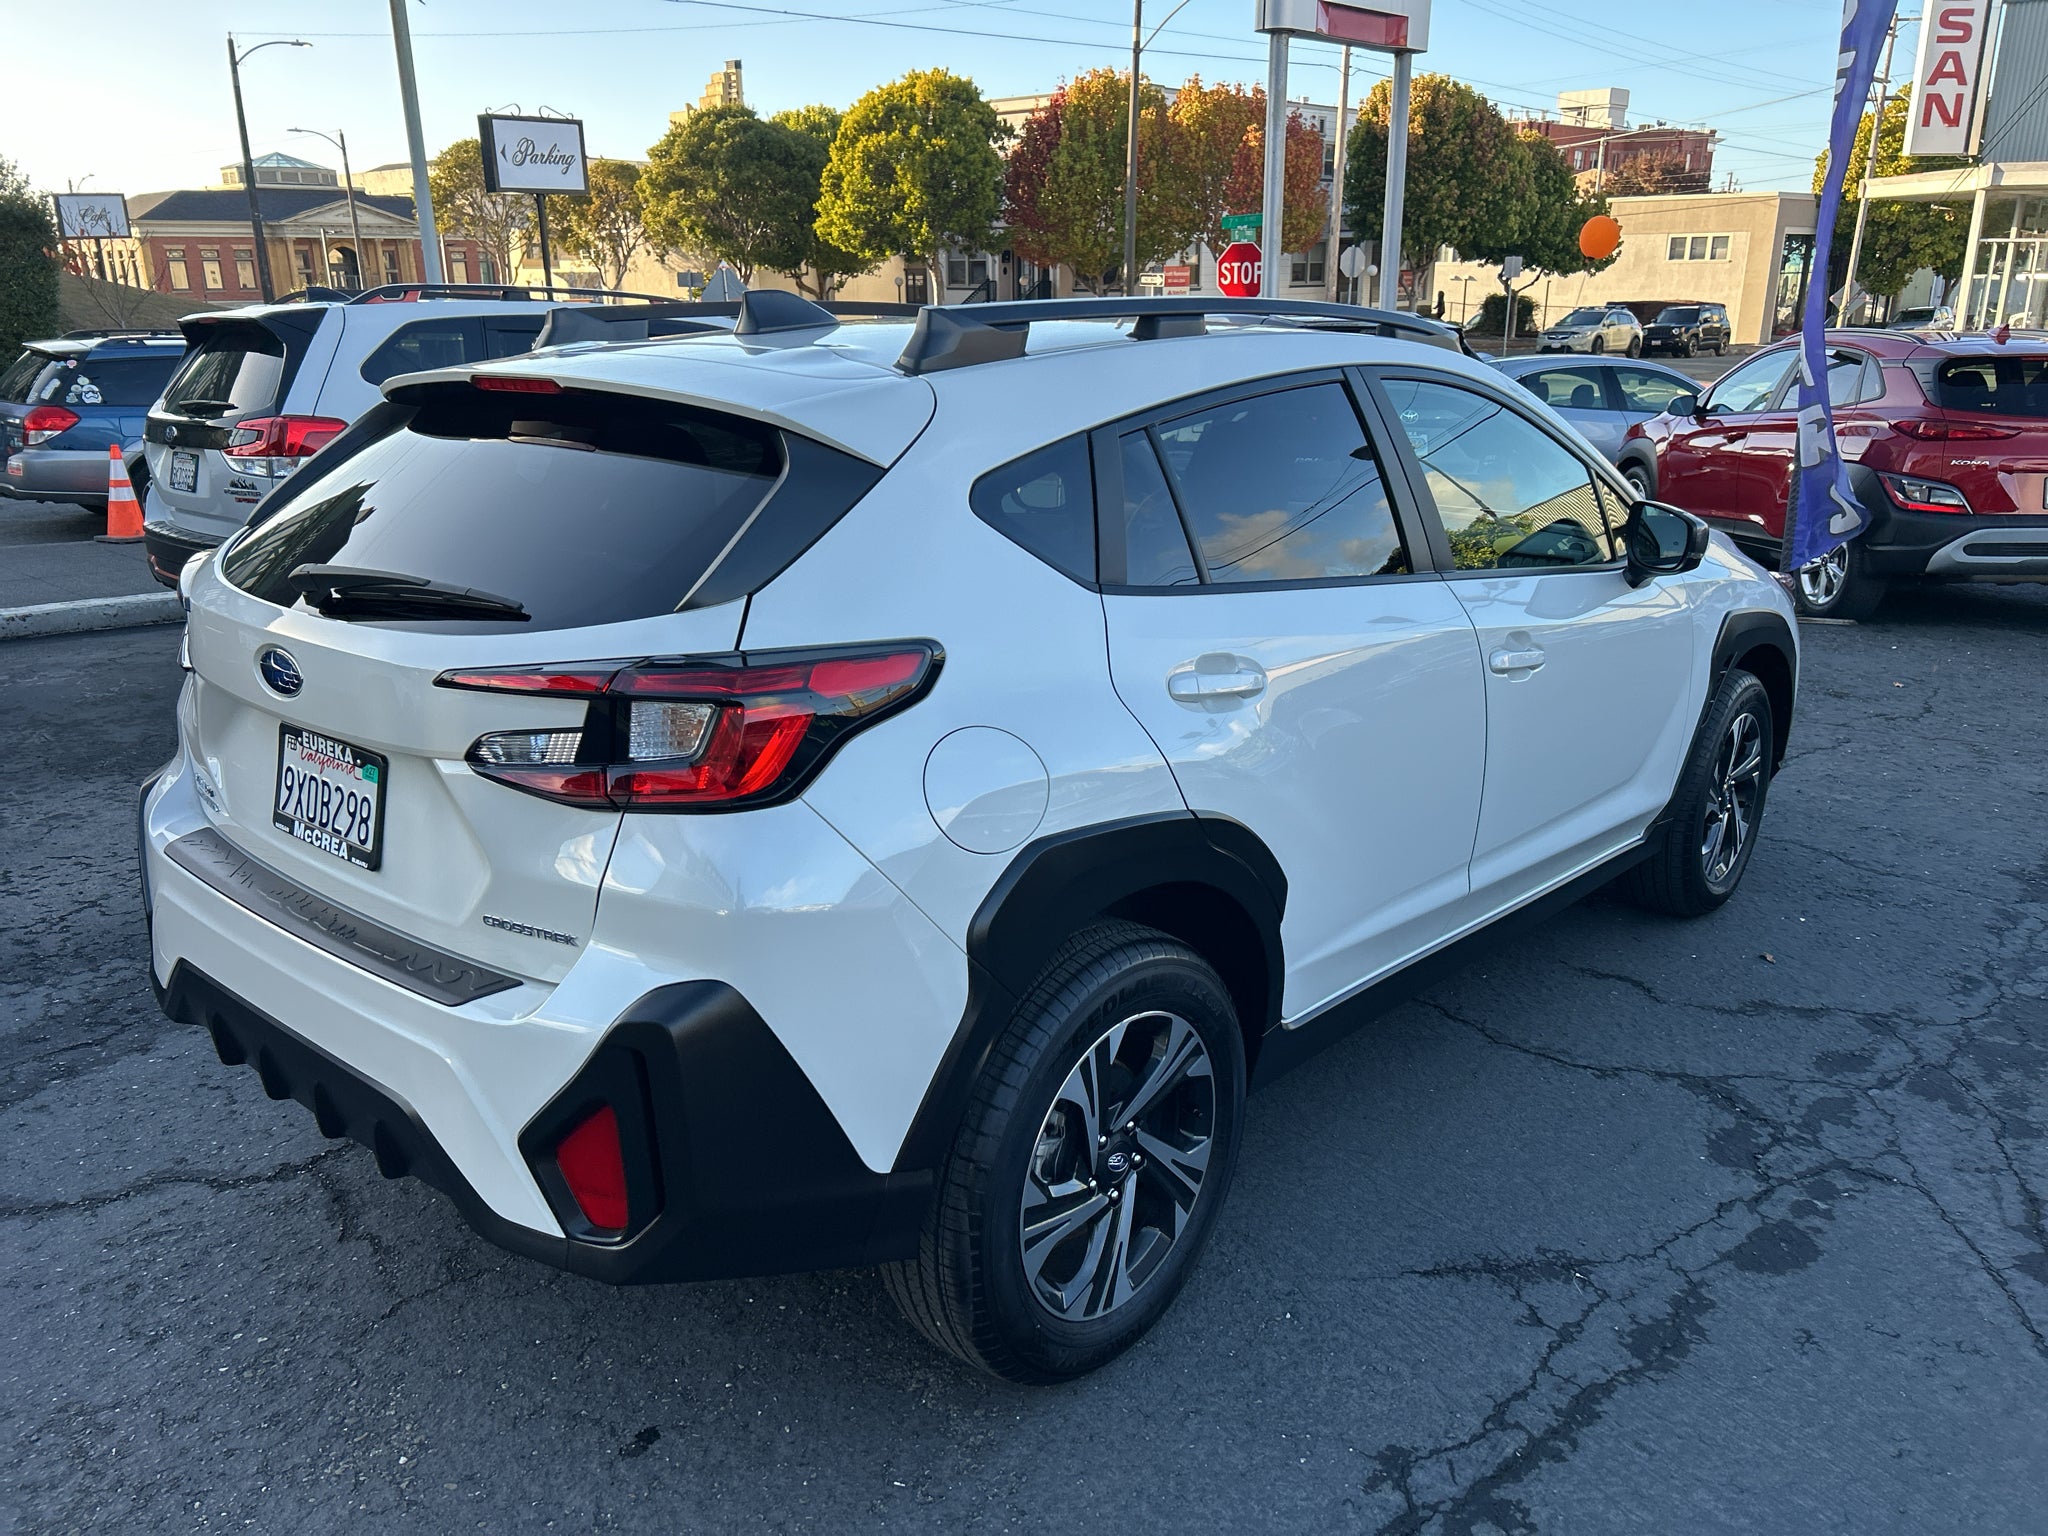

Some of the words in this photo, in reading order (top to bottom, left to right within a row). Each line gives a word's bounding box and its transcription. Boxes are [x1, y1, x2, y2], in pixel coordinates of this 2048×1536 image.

[1921, 0, 1975, 128] SAN
[512, 137, 577, 175] Parking
[302, 731, 354, 764] EUREKA
[293, 820, 349, 860] McCREA
[482, 914, 579, 947] CROSSTREK
